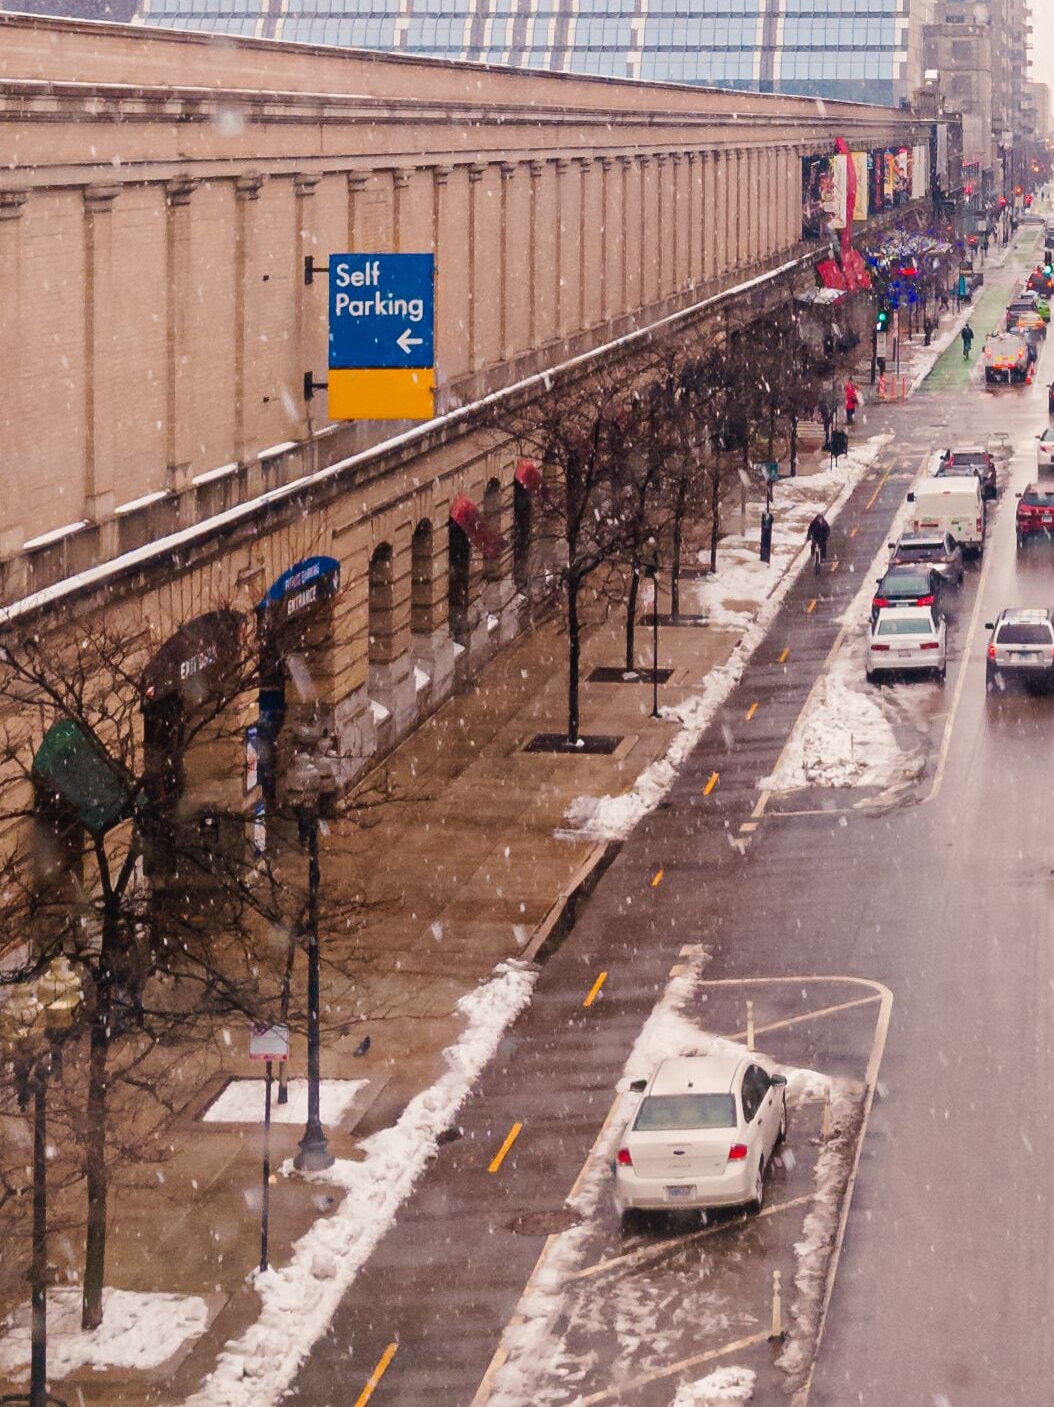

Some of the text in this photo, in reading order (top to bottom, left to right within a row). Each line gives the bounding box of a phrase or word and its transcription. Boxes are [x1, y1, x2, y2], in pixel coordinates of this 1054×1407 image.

[336, 261, 380, 286] Self
[336, 291, 424, 322] Parking
[287, 585, 317, 615] ENTRANCE
